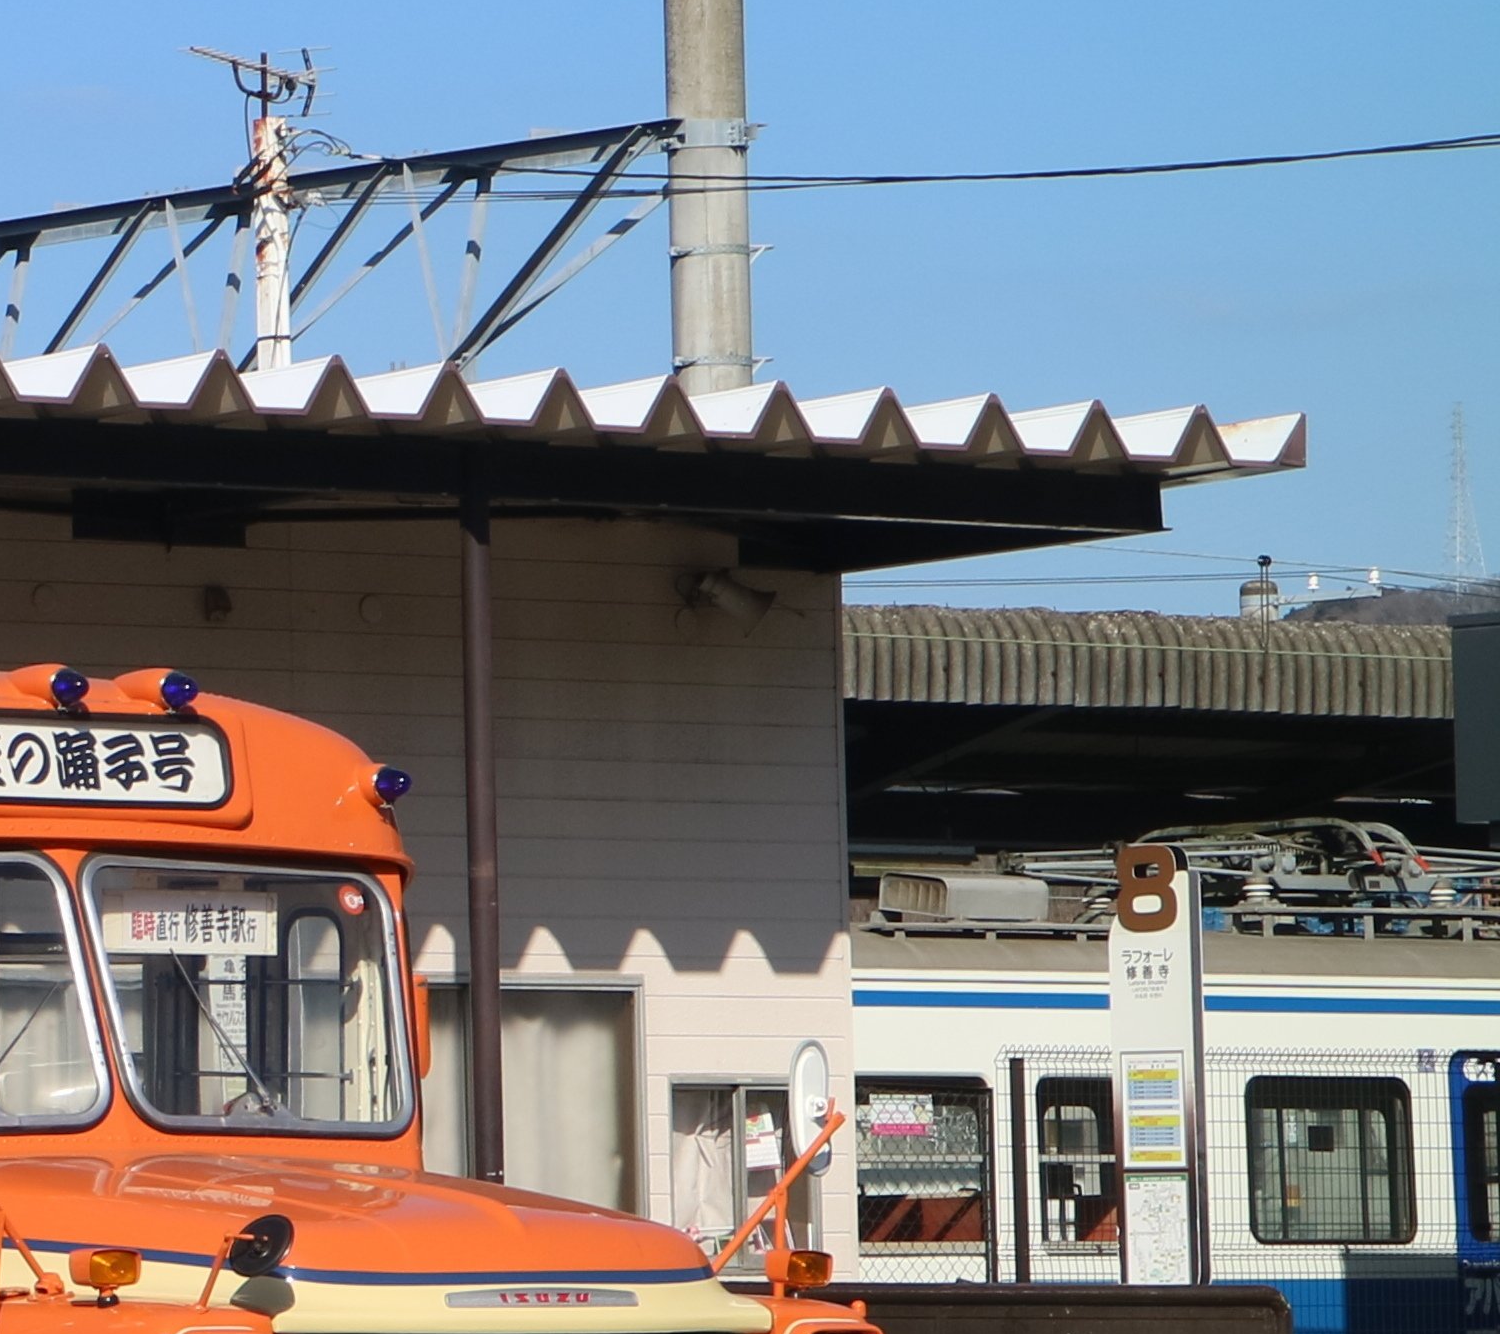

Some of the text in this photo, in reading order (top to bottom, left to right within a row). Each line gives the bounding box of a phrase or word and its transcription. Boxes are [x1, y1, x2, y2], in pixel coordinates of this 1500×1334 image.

[1116, 845, 1178, 933] 8
[1121, 948, 1173, 965] ラフォーレ
[1126, 965, 1170, 980] 修善寺
[499, 1292, 590, 1303] ISUZU
